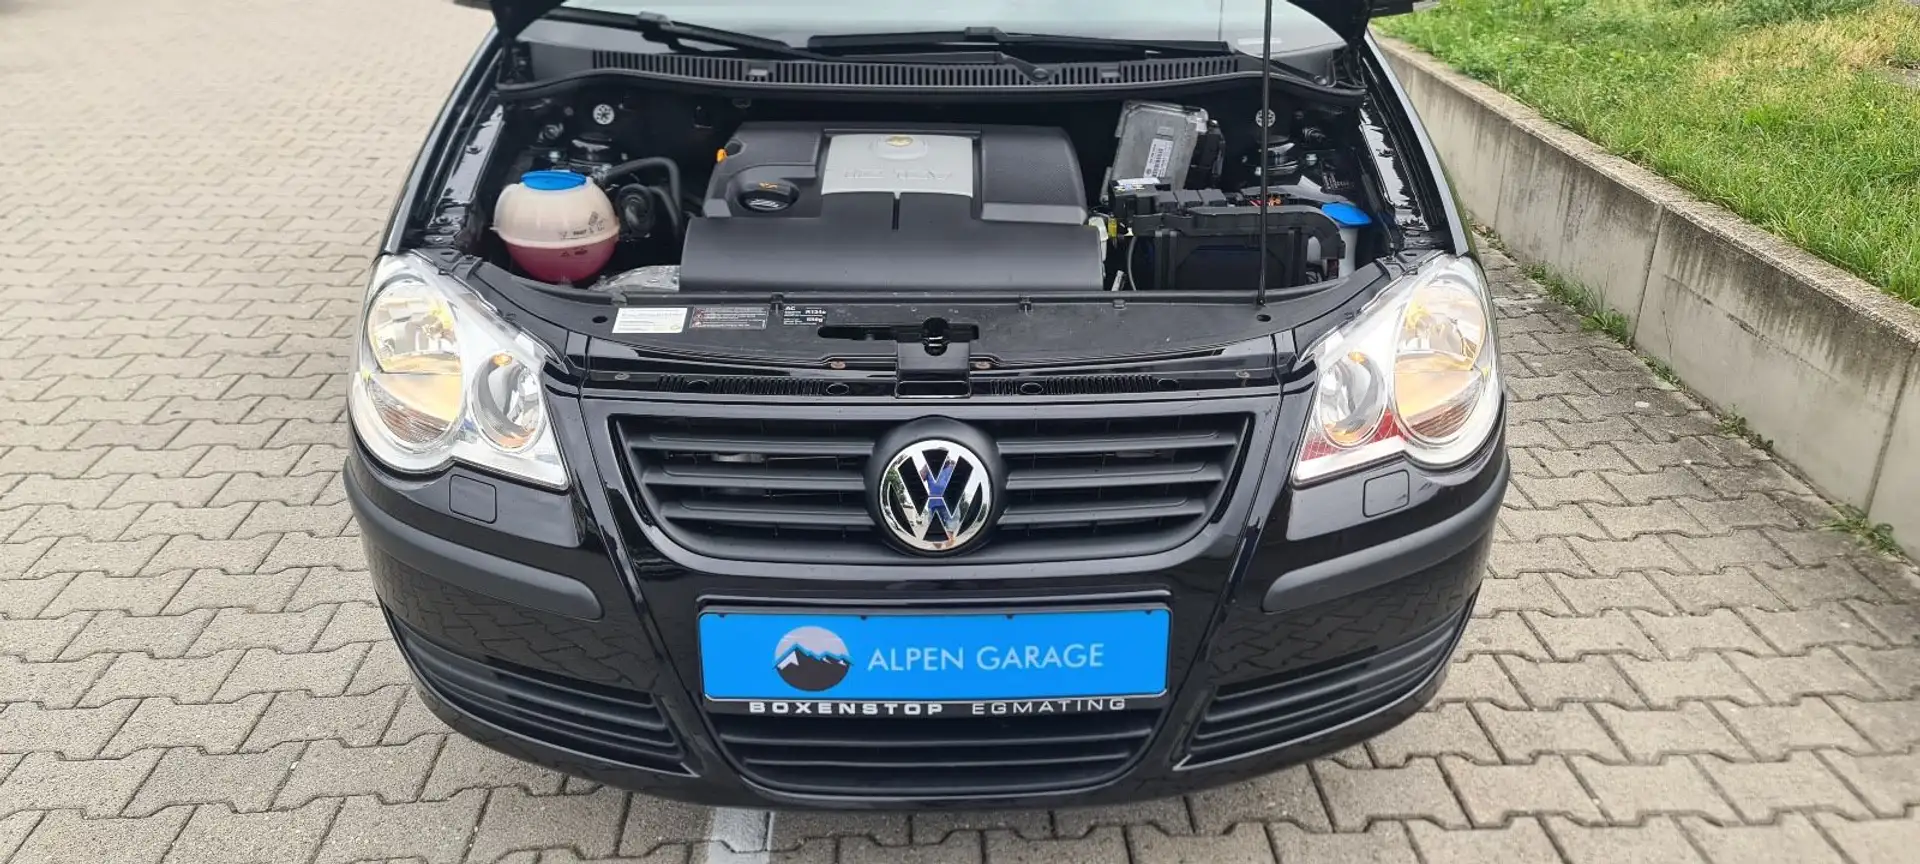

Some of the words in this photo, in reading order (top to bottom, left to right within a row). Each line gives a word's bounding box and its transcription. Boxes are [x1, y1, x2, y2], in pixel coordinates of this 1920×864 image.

[880, 440, 991, 550] VW
[867, 647, 964, 671] ALPEN
[976, 643, 1104, 670] GARAGE
[749, 701, 942, 715] BOXENSTOP
[972, 698, 1126, 715] EGMATING
